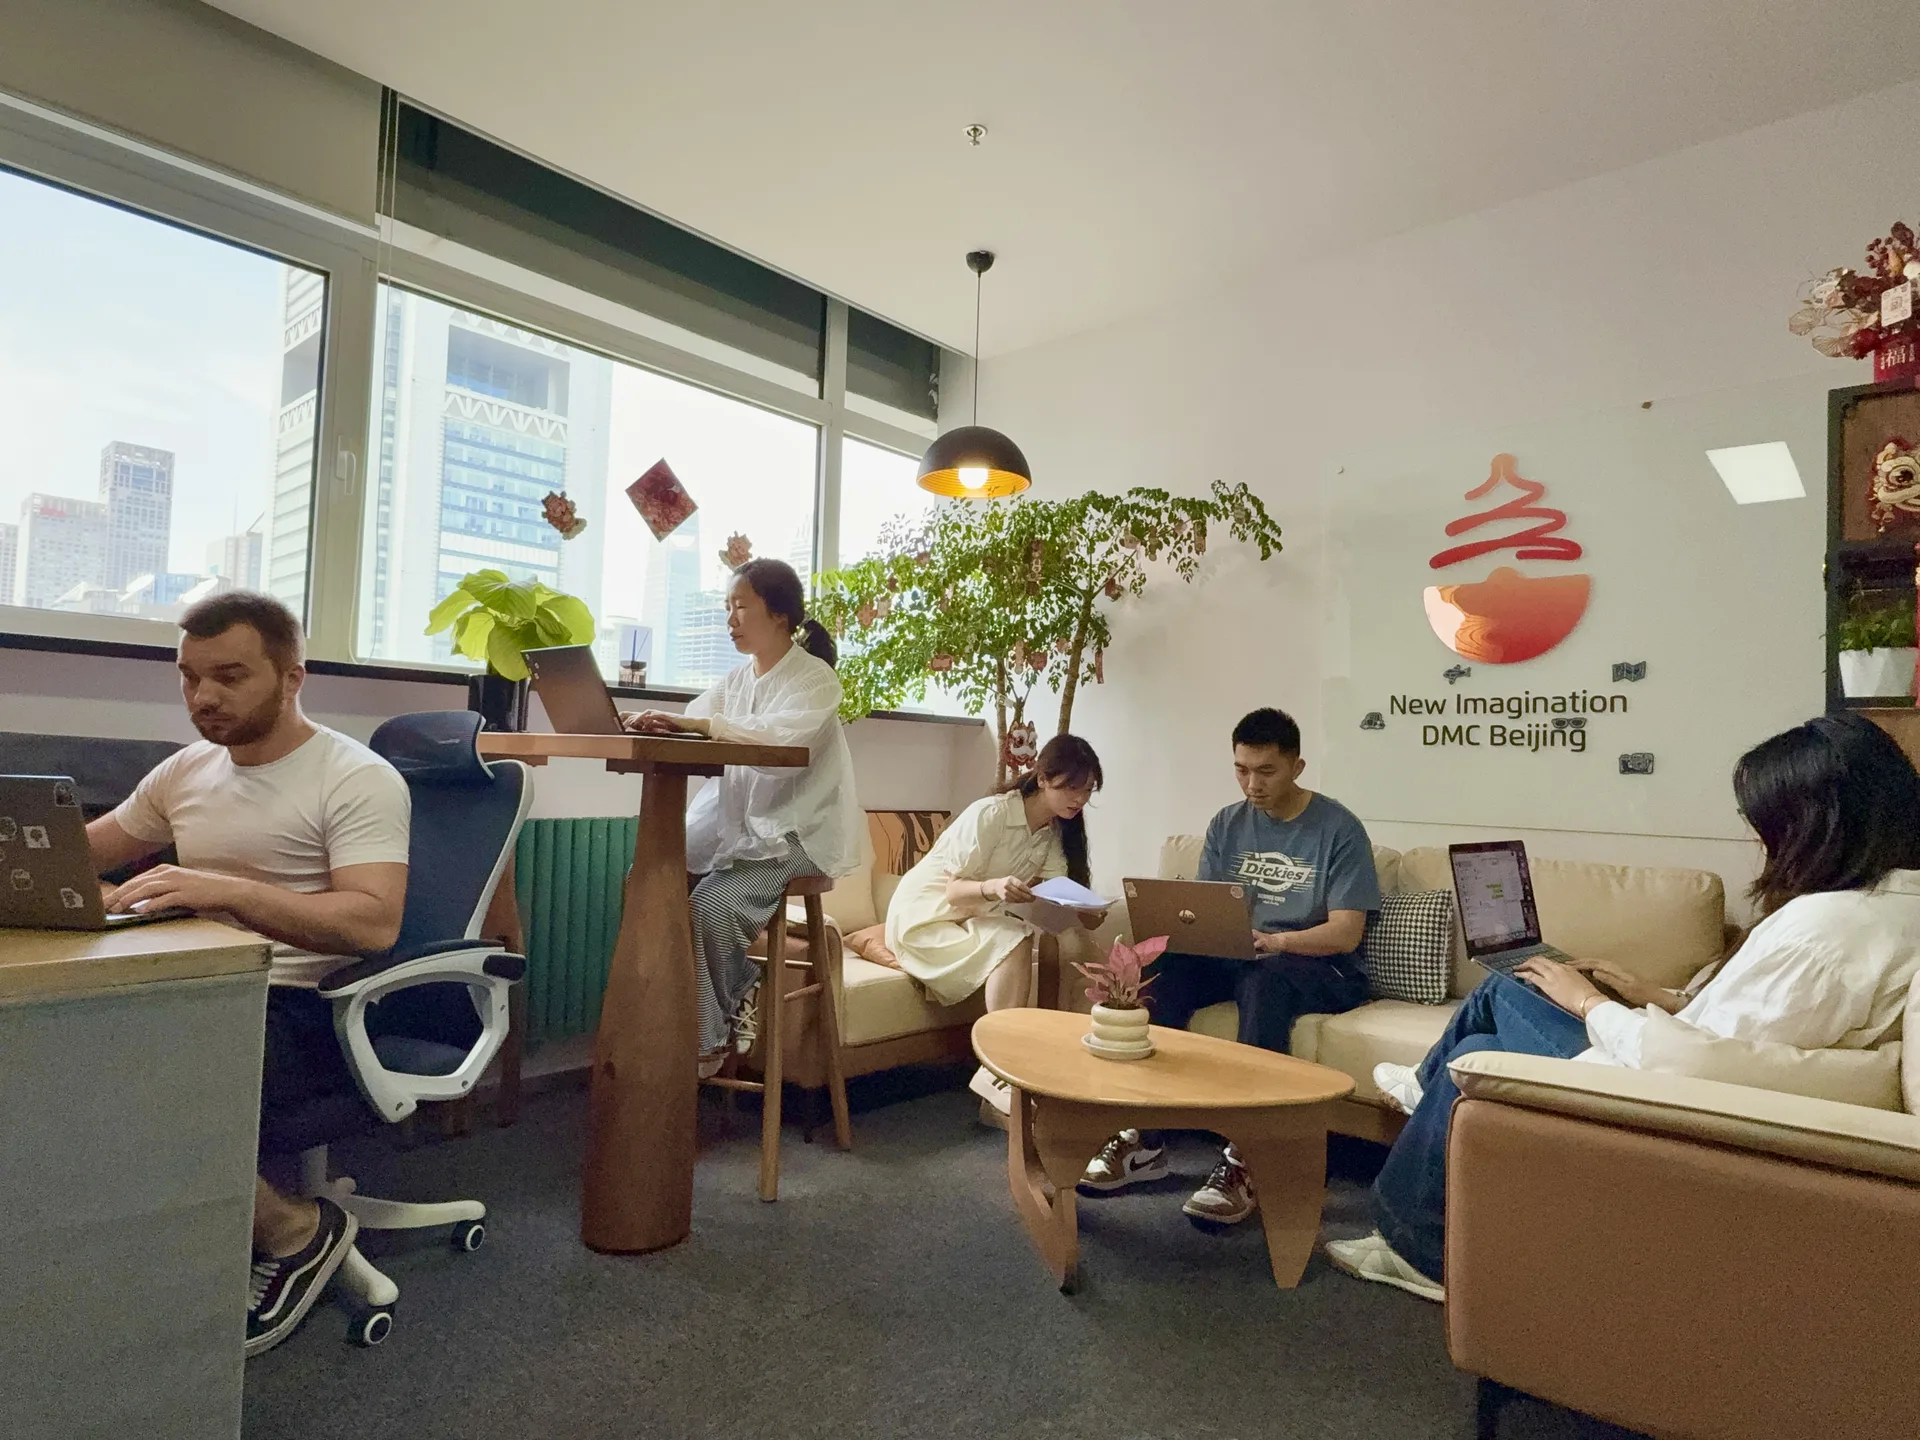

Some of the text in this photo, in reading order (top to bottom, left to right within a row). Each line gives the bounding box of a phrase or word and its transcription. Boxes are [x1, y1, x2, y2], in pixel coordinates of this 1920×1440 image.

[1390, 689, 1628, 720] New Imagination
[1422, 723, 1587, 752] DMC Beijing
[1244, 863, 1304, 880] Dickies
